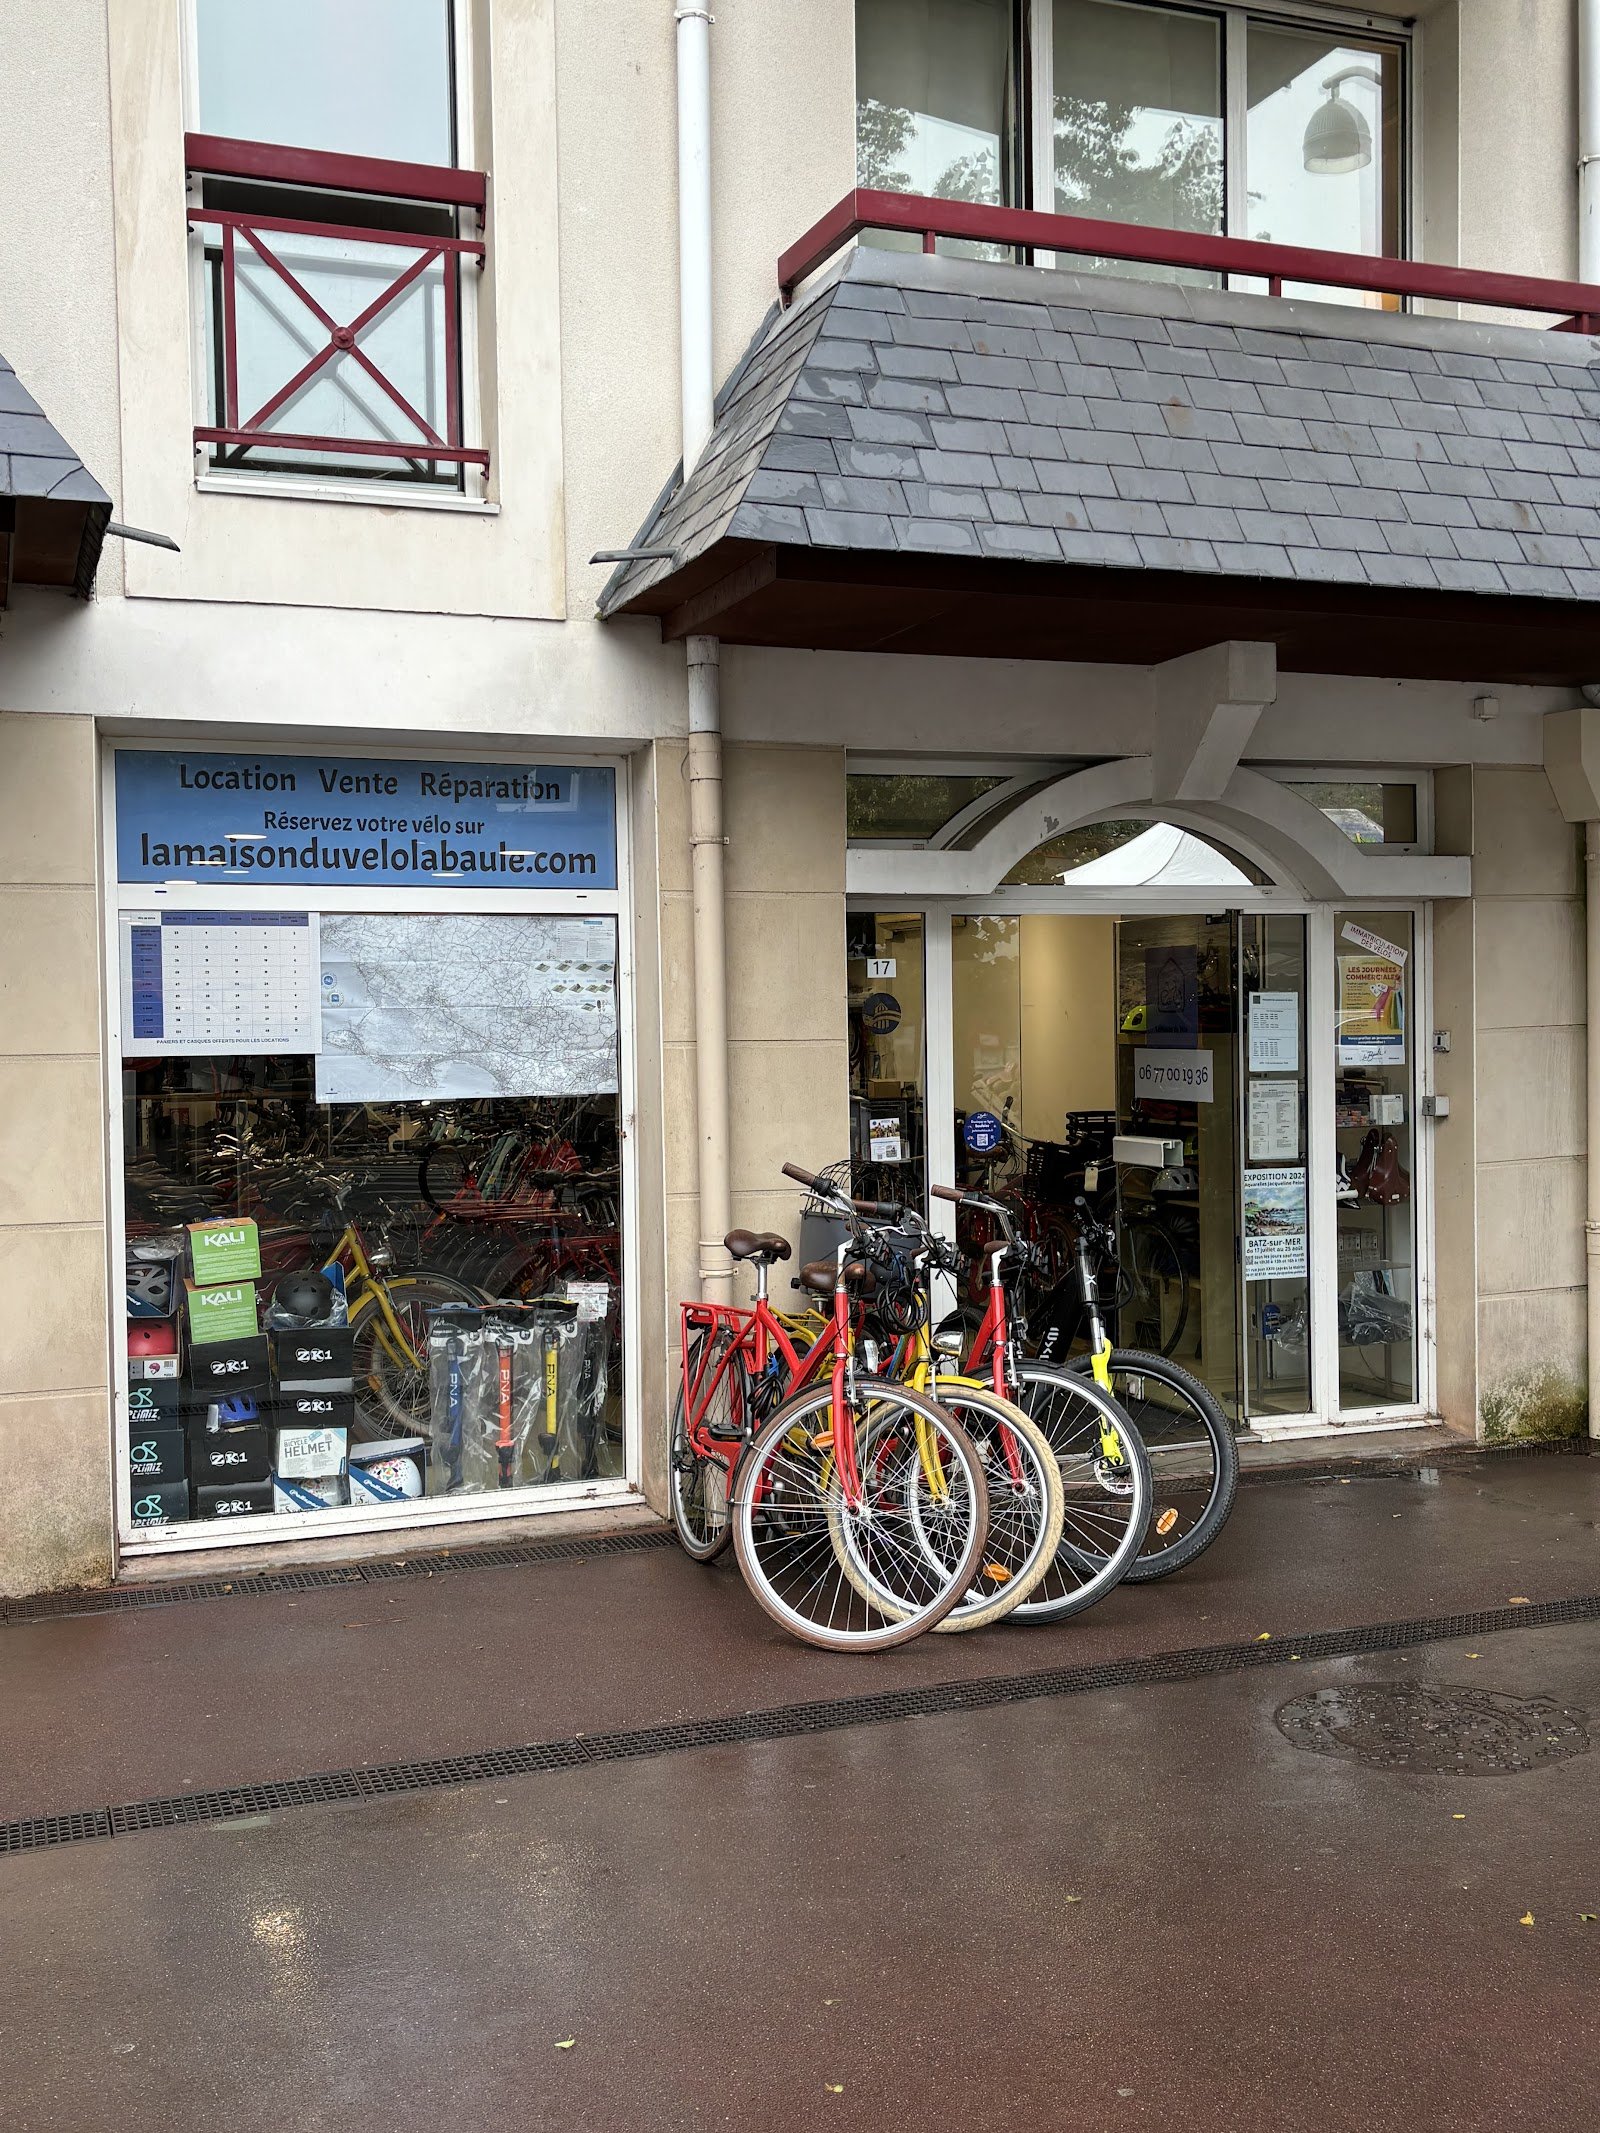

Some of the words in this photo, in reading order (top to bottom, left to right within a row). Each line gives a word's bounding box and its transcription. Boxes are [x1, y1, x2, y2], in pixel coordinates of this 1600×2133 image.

[181, 764, 296, 791] Location
[318, 768, 398, 795] Vente
[420, 772, 560, 803] Réparation
[264, 811, 352, 832] Réservez
[356, 815, 408, 833] votre
[411, 814, 451, 834] vélo
[455, 820, 485, 834] sur
[141, 832, 597, 874] lamaisonduvelolabaule.com
[1350, 925, 1405, 957] IMMATRICULATION
[1360, 938, 1373, 950] DES
[873, 960, 890, 975] 17
[1361, 965, 1397, 973] JOURNÉES
[1345, 973, 1400, 981] COMMERCIALES
[1139, 1064, 1152, 1080] 06
[1153, 1067, 1165, 1083] 77
[1166, 1068, 1180, 1081] 00
[1182, 1068, 1193, 1085] 19
[1195, 1067, 1208, 1085] 36
[1244, 1173, 1288, 1182] EXPOSITION
[1289, 1172, 1305, 1180] 2024
[204, 1231, 245, 1247] KALI
[1248, 1237, 1301, 1248] BATZ-sur-MER
[201, 1289, 242, 1306] KALI
[295, 1348, 333, 1363] ZK1
[210, 1359, 249, 1375] ZK1
[296, 1398, 334, 1414] ZK1
[283, 1438, 308, 1448] BICYCLE
[284, 1440, 333, 1458] HELMET
[210, 1451, 248, 1467] ZK1
[215, 1499, 253, 1515] ZK1
